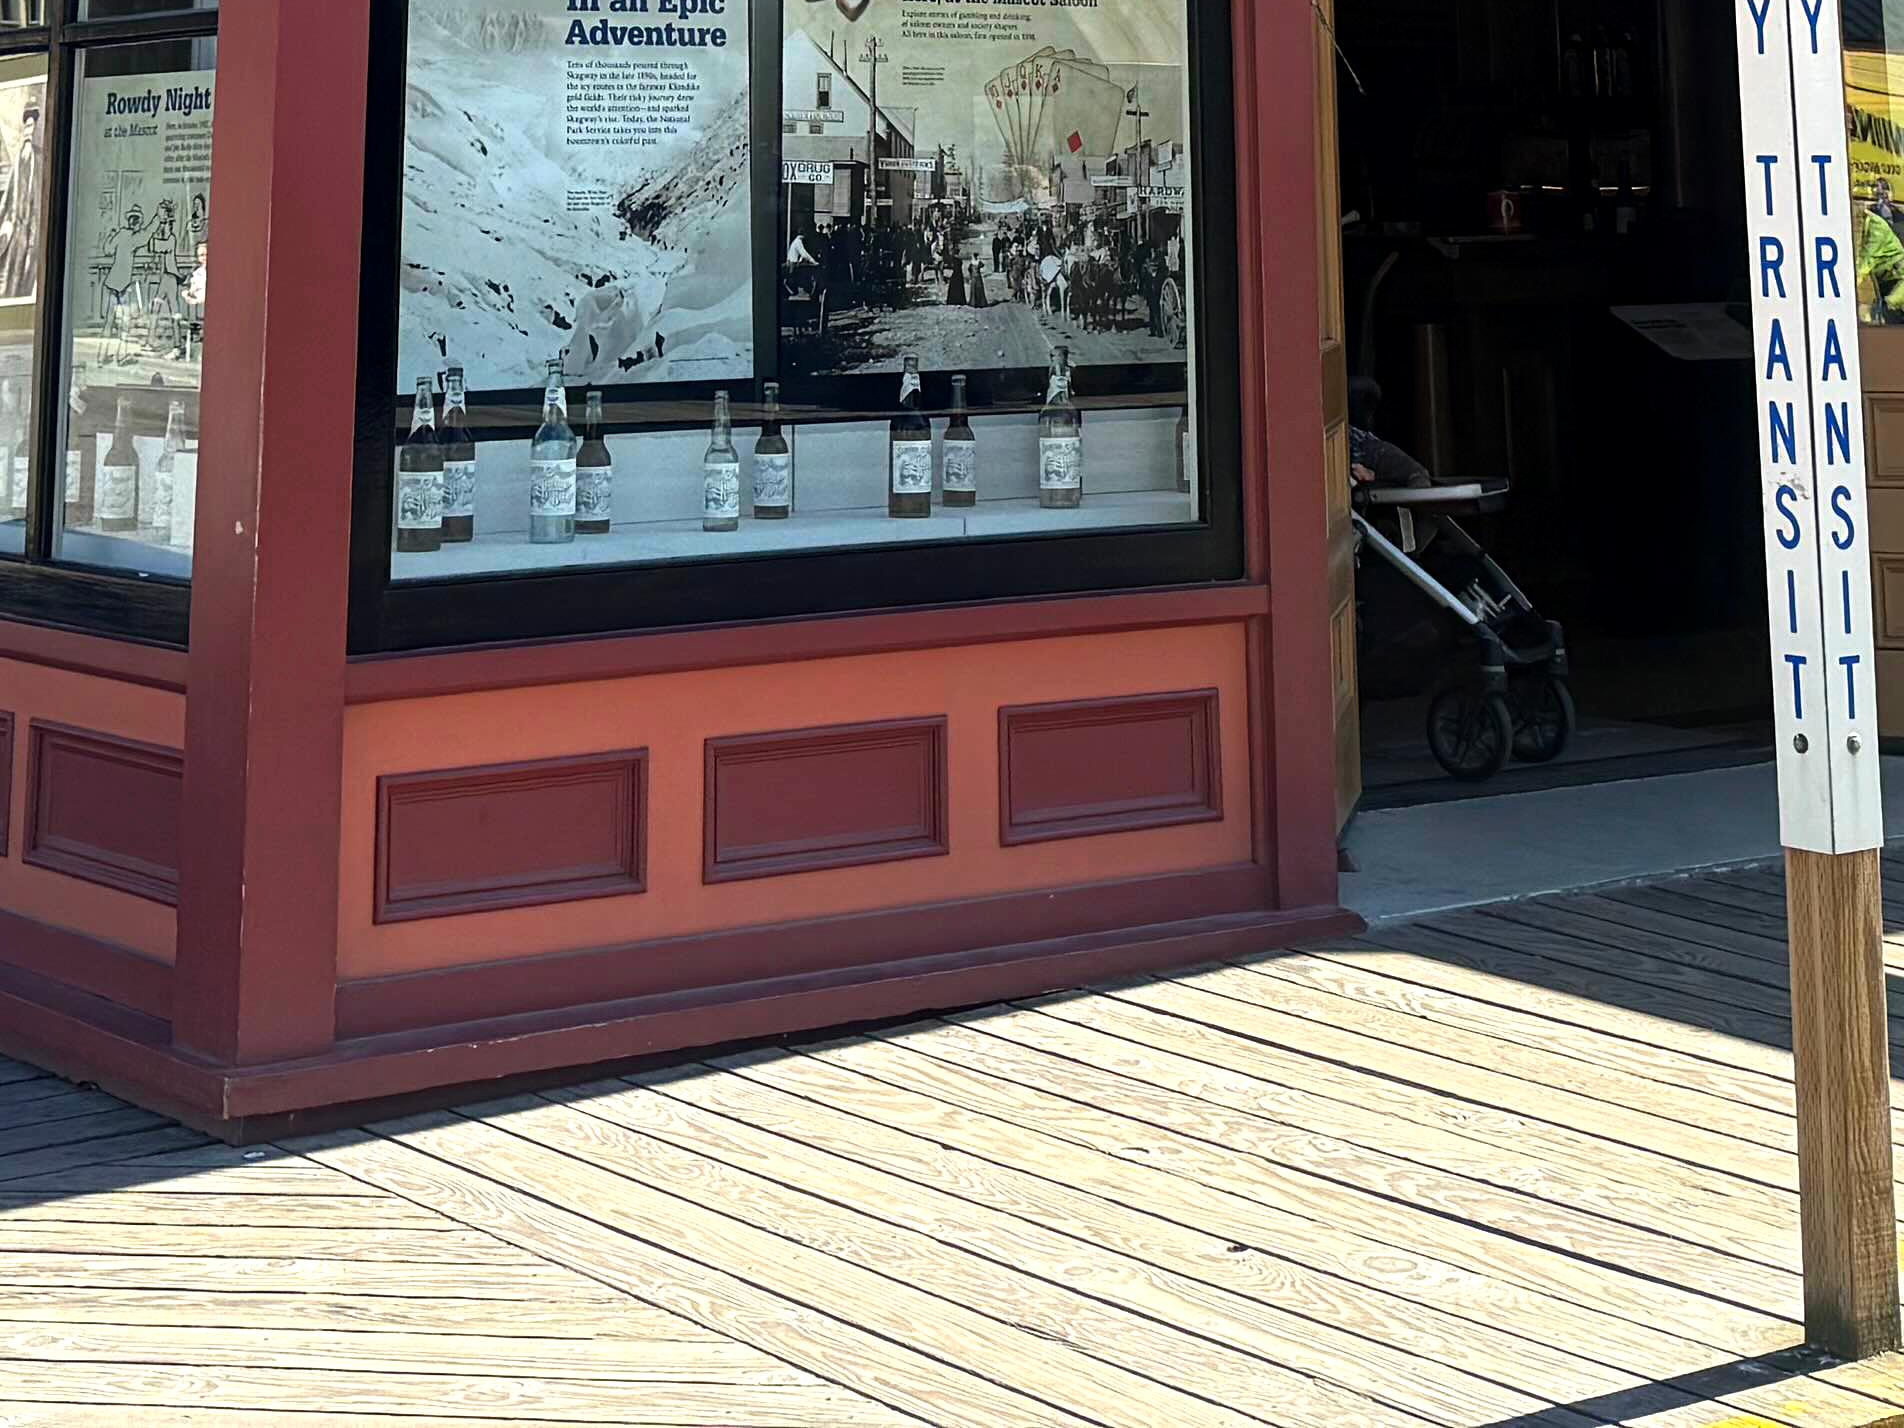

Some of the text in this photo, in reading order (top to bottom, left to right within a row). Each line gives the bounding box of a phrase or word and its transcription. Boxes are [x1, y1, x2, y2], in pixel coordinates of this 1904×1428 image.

[565, 19, 726, 47] Adventure
[660, 61, 688, 71] through
[1035, 64, 1043, 78] K
[106, 86, 211, 118] Rowdy Night
[567, 126, 582, 134] Park
[585, 126, 611, 134] Service
[613, 126, 631, 134] takes
[664, 126, 677, 134] this
[798, 163, 830, 173] DRUG
[1756, 155, 1808, 720] TRANSIT
[1811, 155, 1860, 720] TRANSIT
